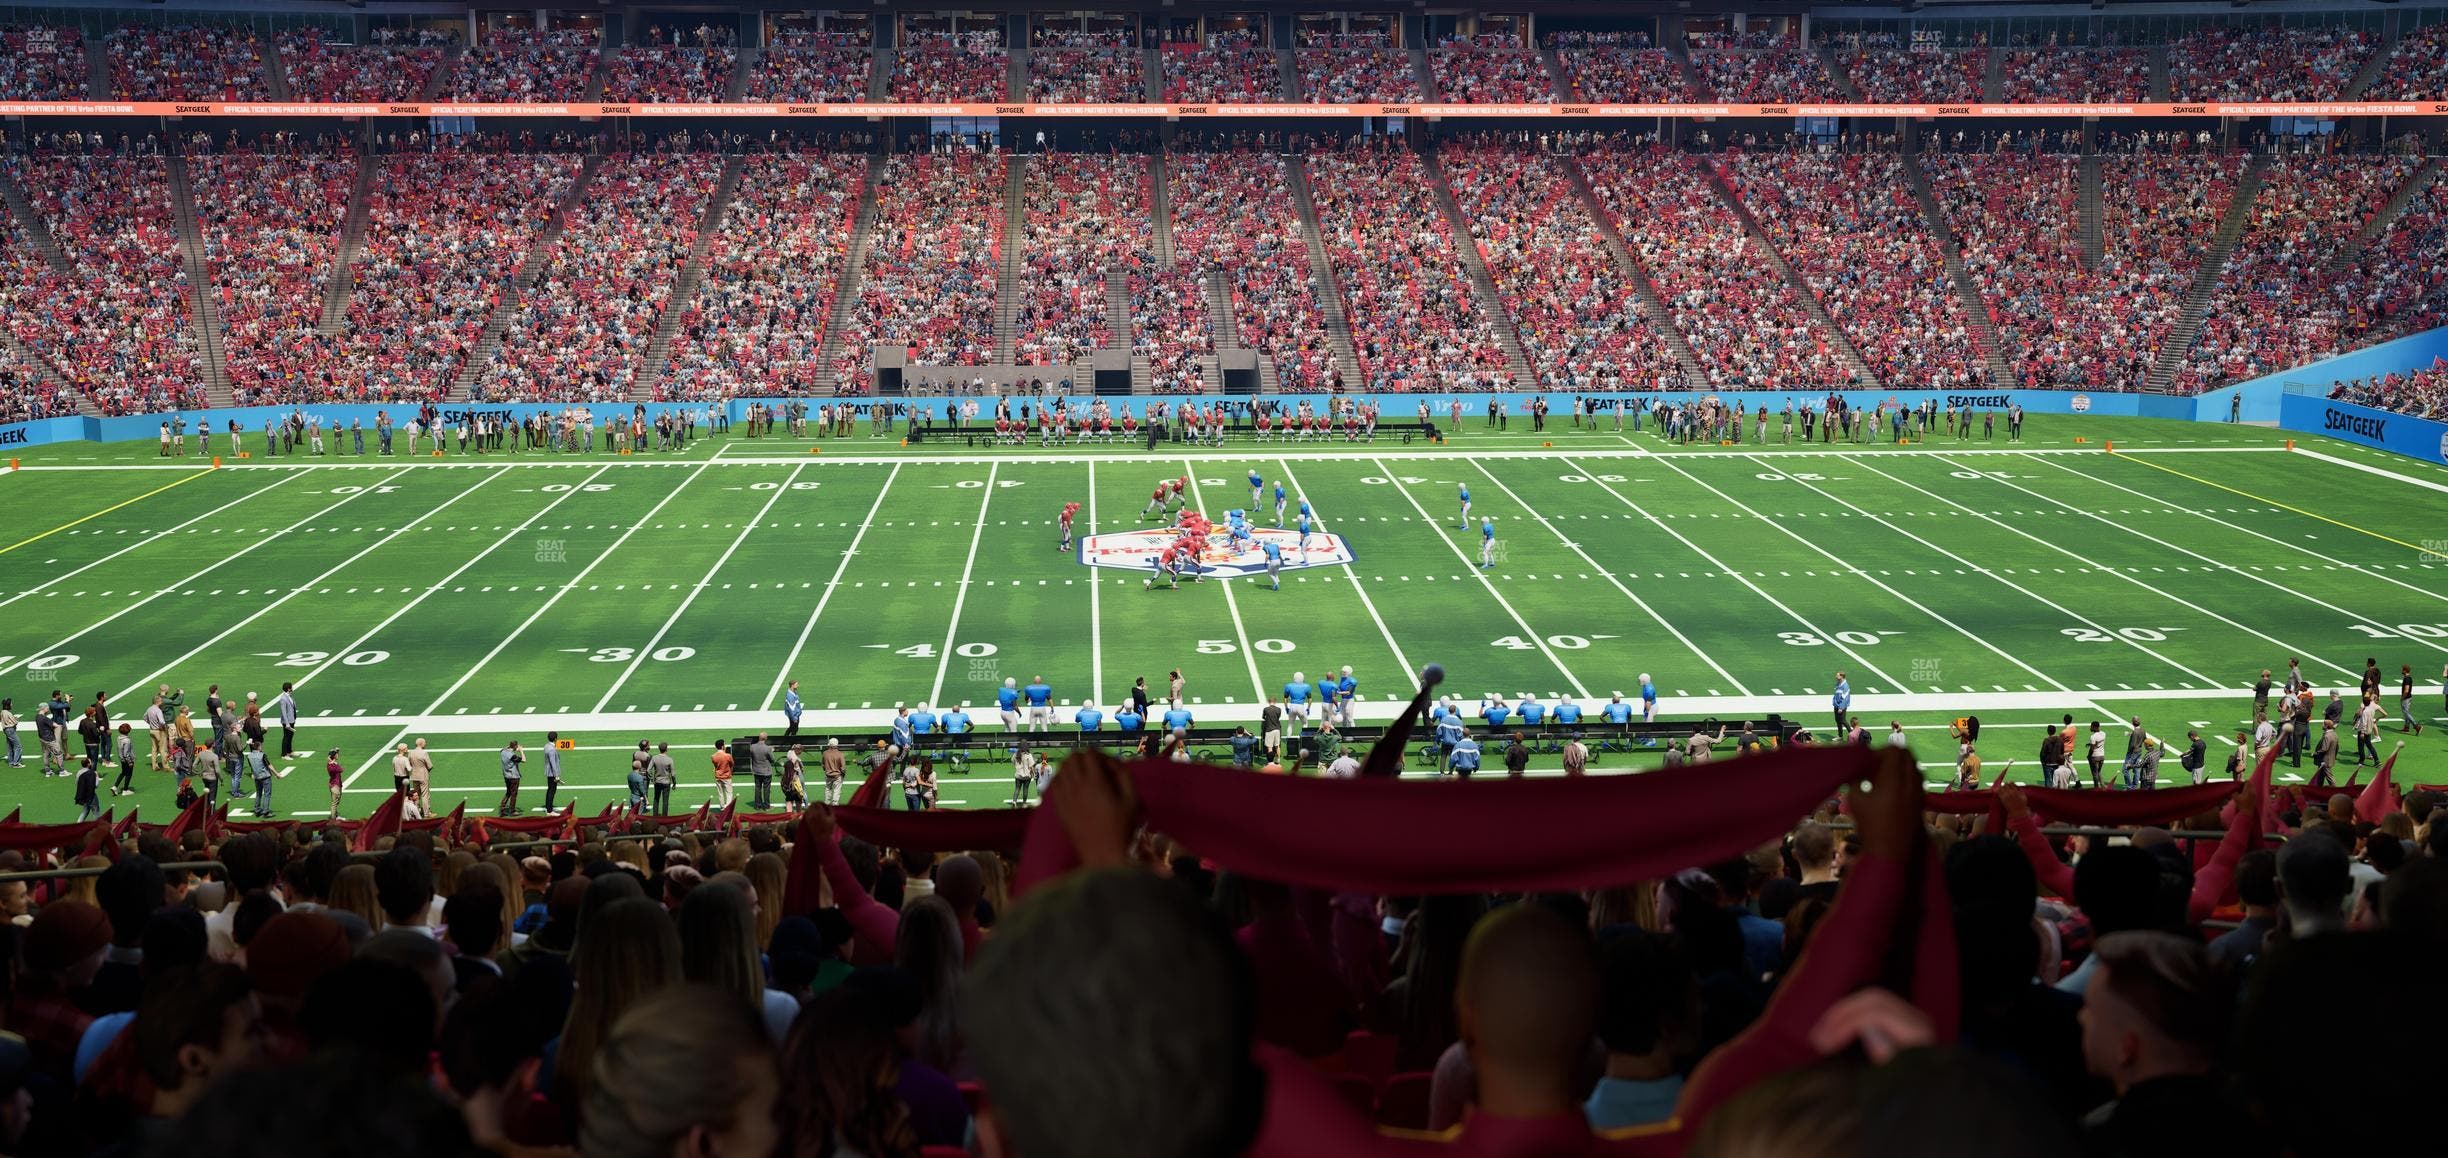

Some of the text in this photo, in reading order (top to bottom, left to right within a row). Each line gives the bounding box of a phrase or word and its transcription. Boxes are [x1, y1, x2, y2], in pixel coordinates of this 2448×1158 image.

[1946, 394, 2010, 408] SEATGEEK
[2324, 408, 2386, 442] SEATGEEK
[2060, 628, 2166, 642] 20
[2347, 624, 2448, 638] 10
[1491, 636, 1590, 650] 40
[1777, 632, 1880, 646] 30
[896, 642, 998, 657] 40
[1196, 639, 1296, 654] 50
[274, 651, 390, 666] 20
[588, 647, 696, 662] 30
[561, 741, 570, 749] 30
